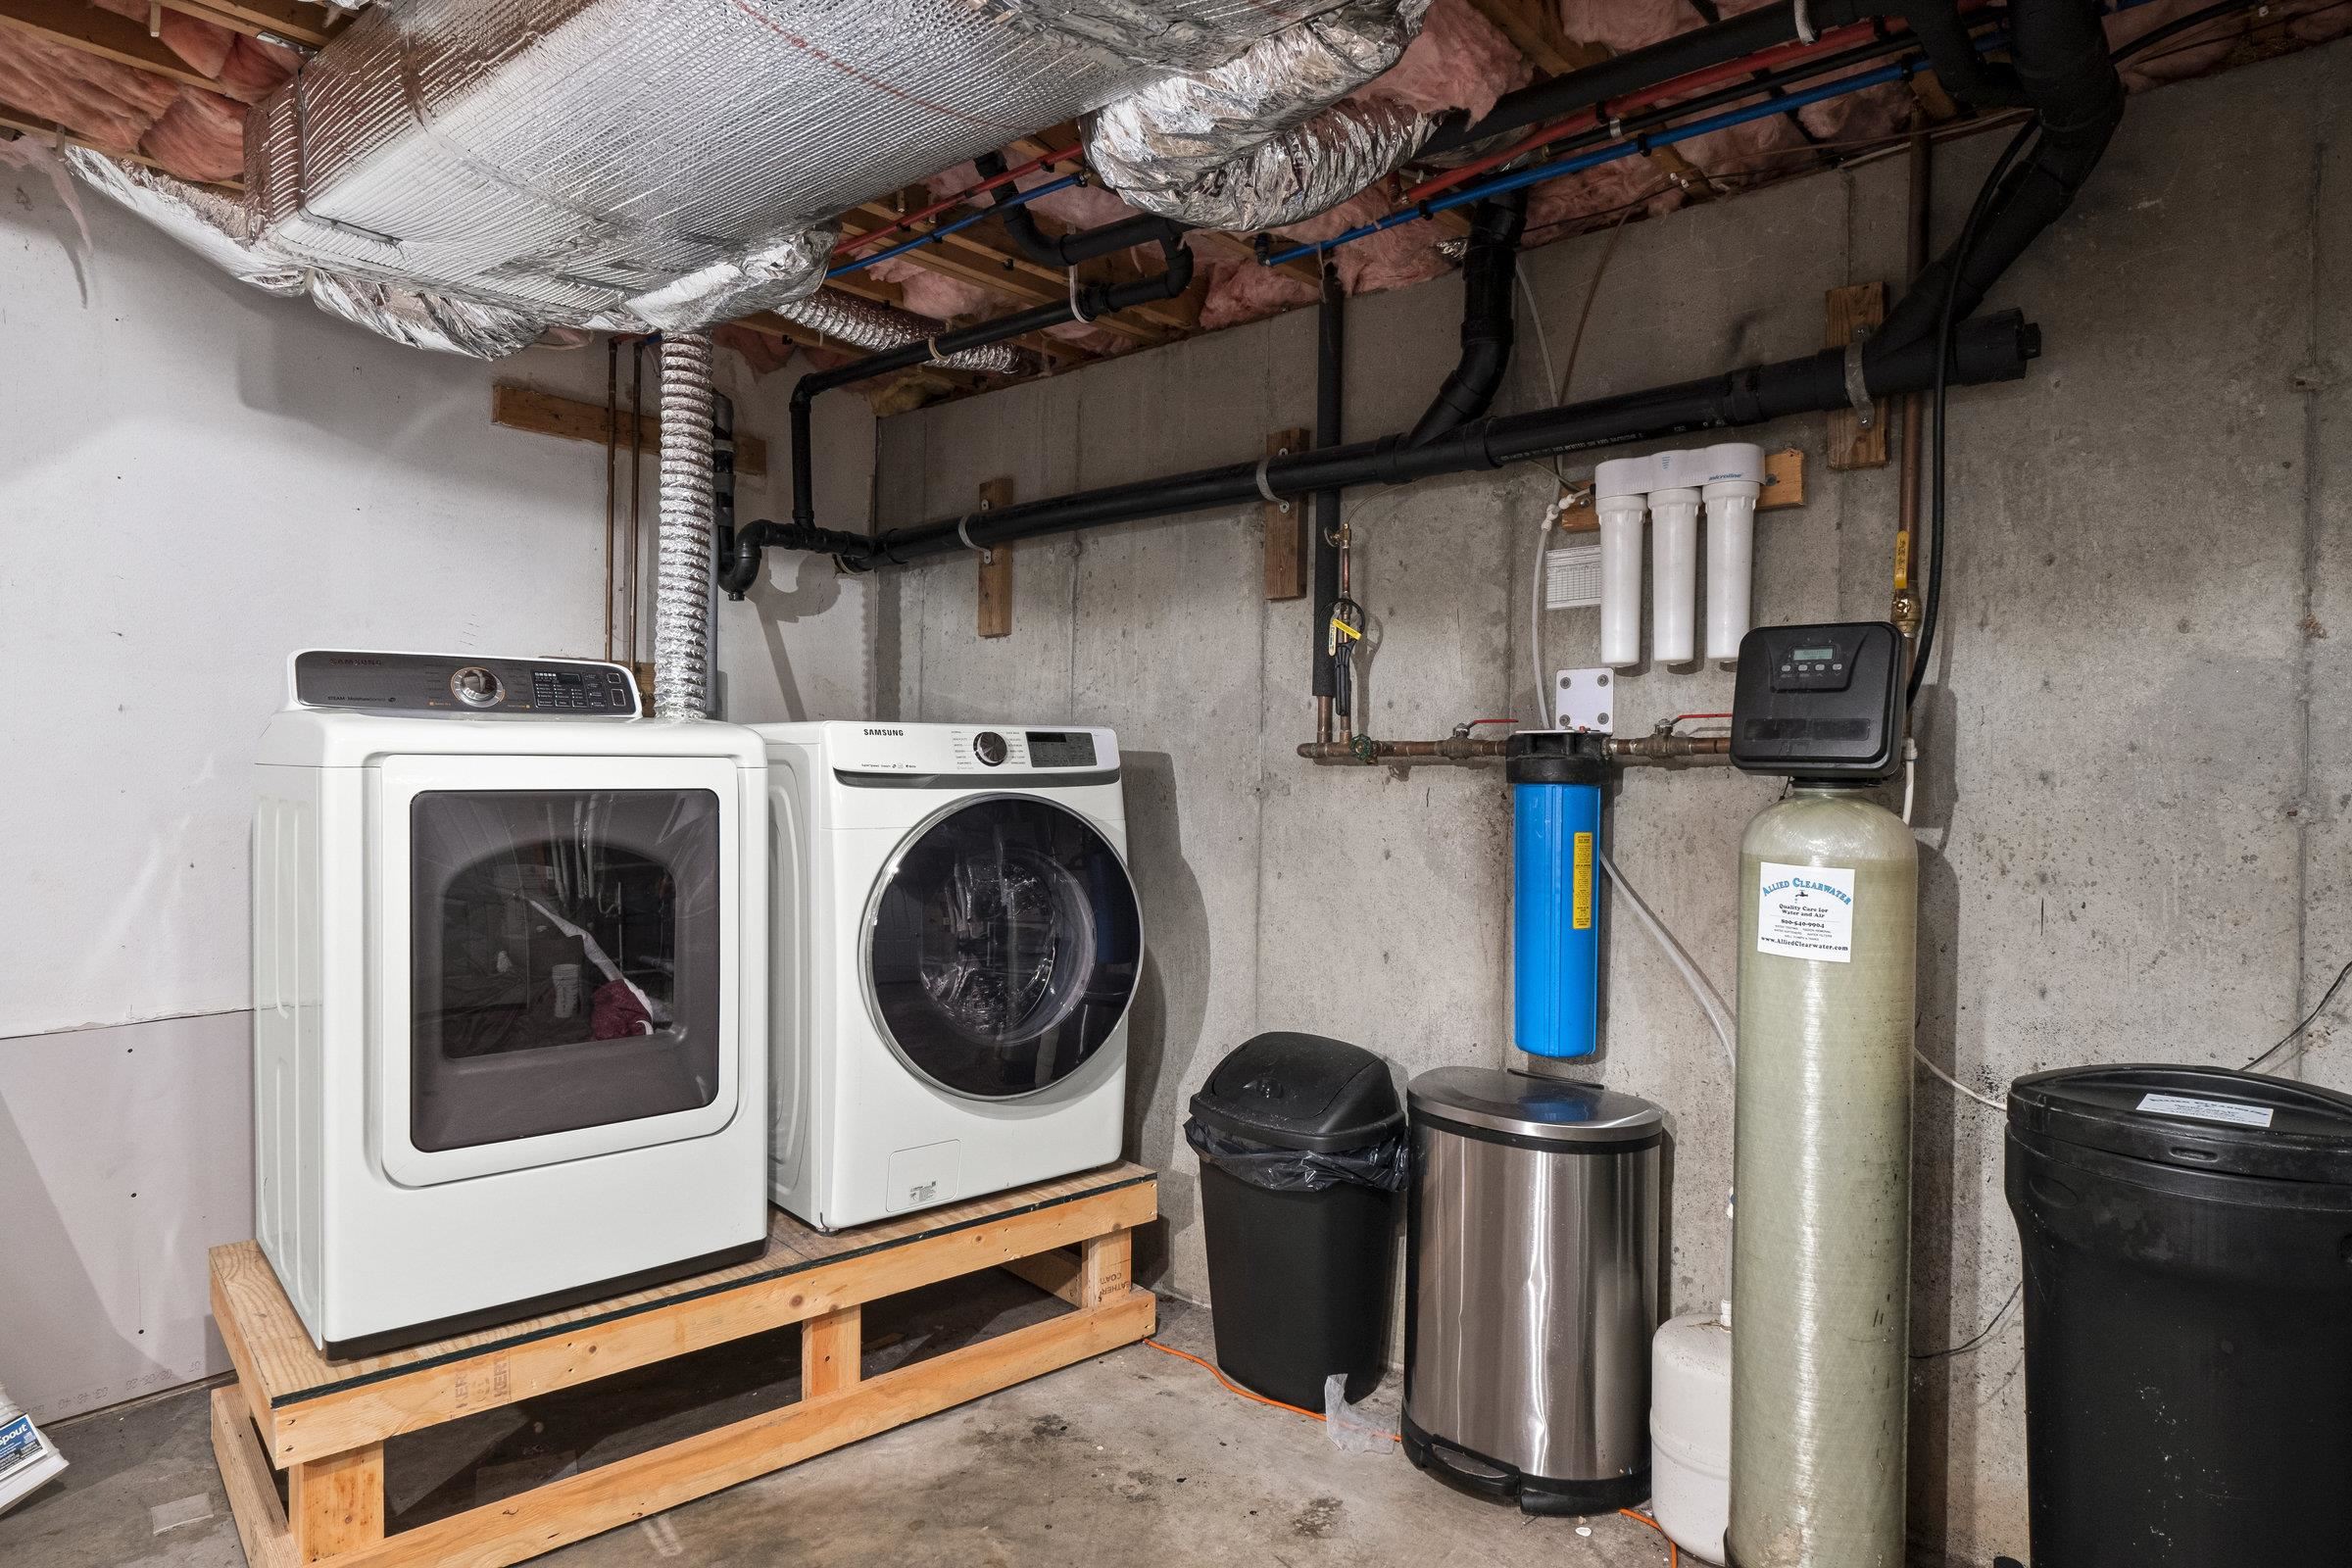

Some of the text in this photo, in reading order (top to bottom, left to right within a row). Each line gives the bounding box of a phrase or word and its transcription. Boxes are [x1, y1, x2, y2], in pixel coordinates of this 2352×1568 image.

[329, 658, 382, 667] SAMSUNG
[862, 728, 904, 737] SAMSUNG
[1762, 877, 1851, 906] ALLIED CLEARWATER
[1760, 936, 1849, 952] www.AlliedClearwater.com
